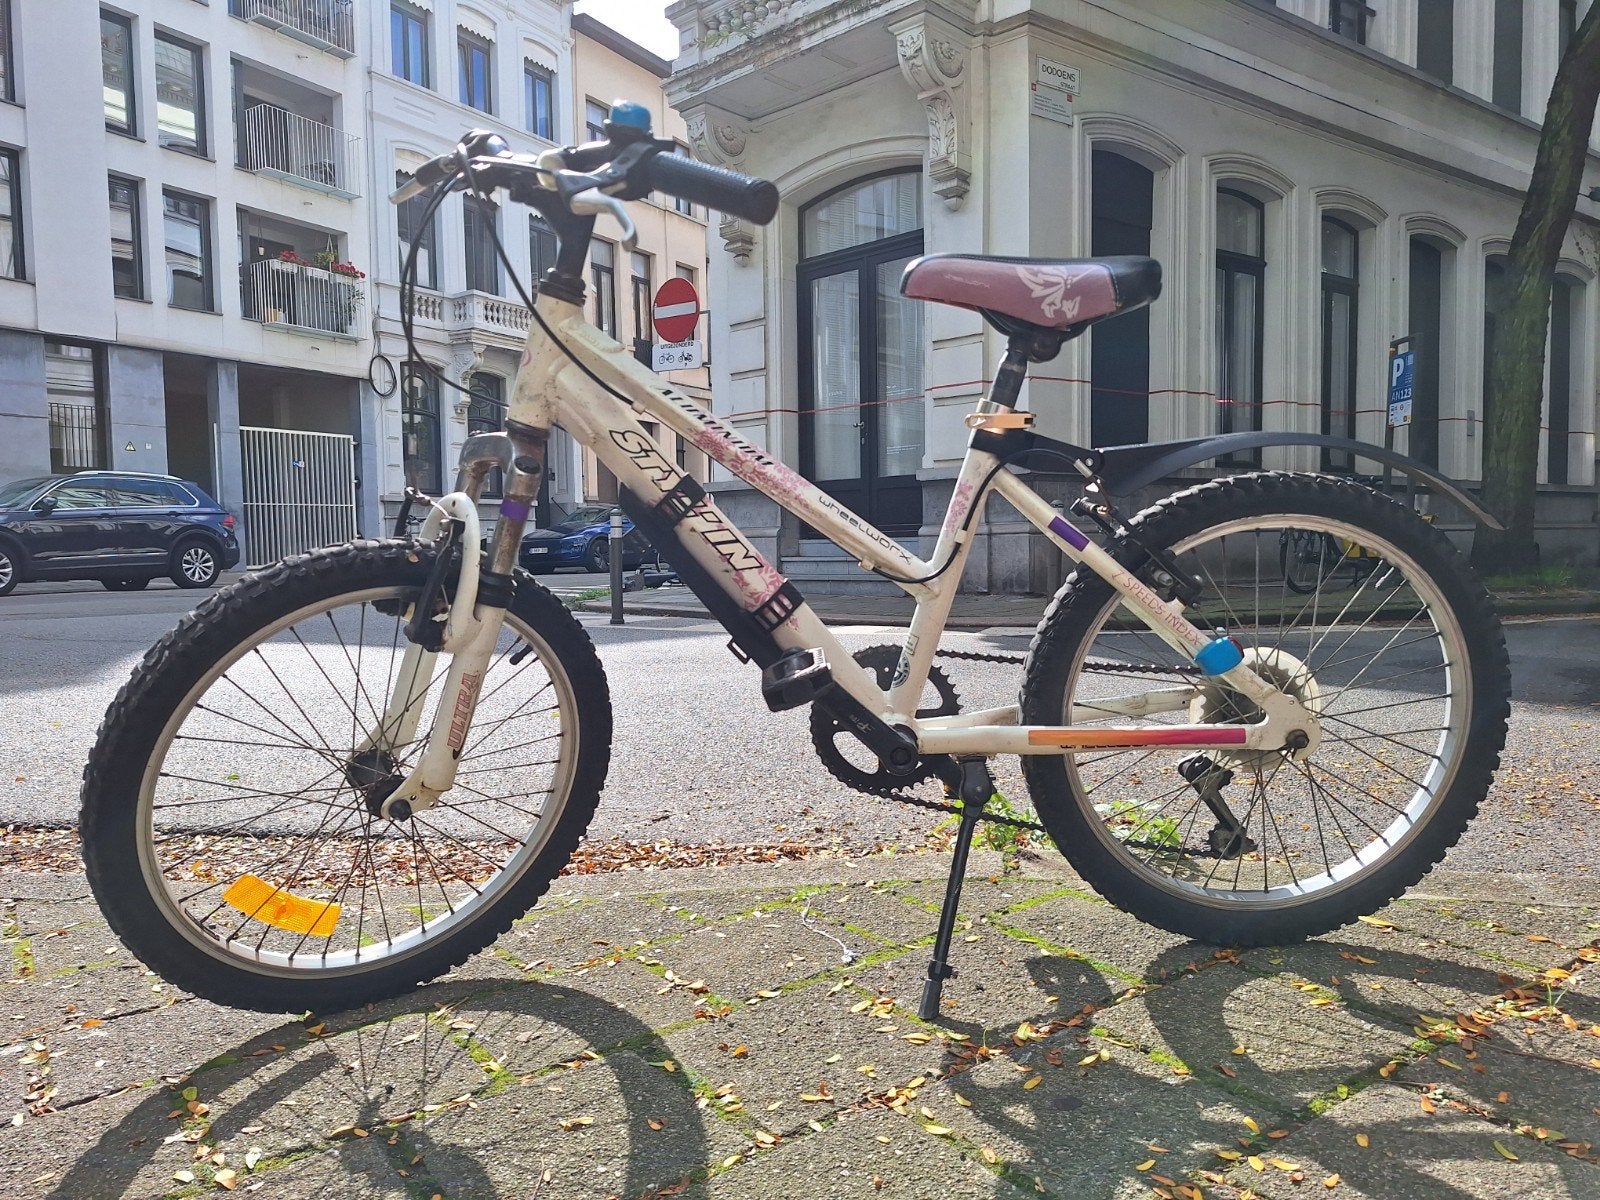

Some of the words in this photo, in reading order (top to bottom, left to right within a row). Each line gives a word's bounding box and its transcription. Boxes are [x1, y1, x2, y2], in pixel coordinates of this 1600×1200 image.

[1041, 64, 1076, 82] DODOENS
[1392, 358, 1404, 387] P
[1124, 578, 1166, 614] SPEEDS
[1165, 613, 1202, 645] INDEX
[447, 673, 478, 748] ULTRA
